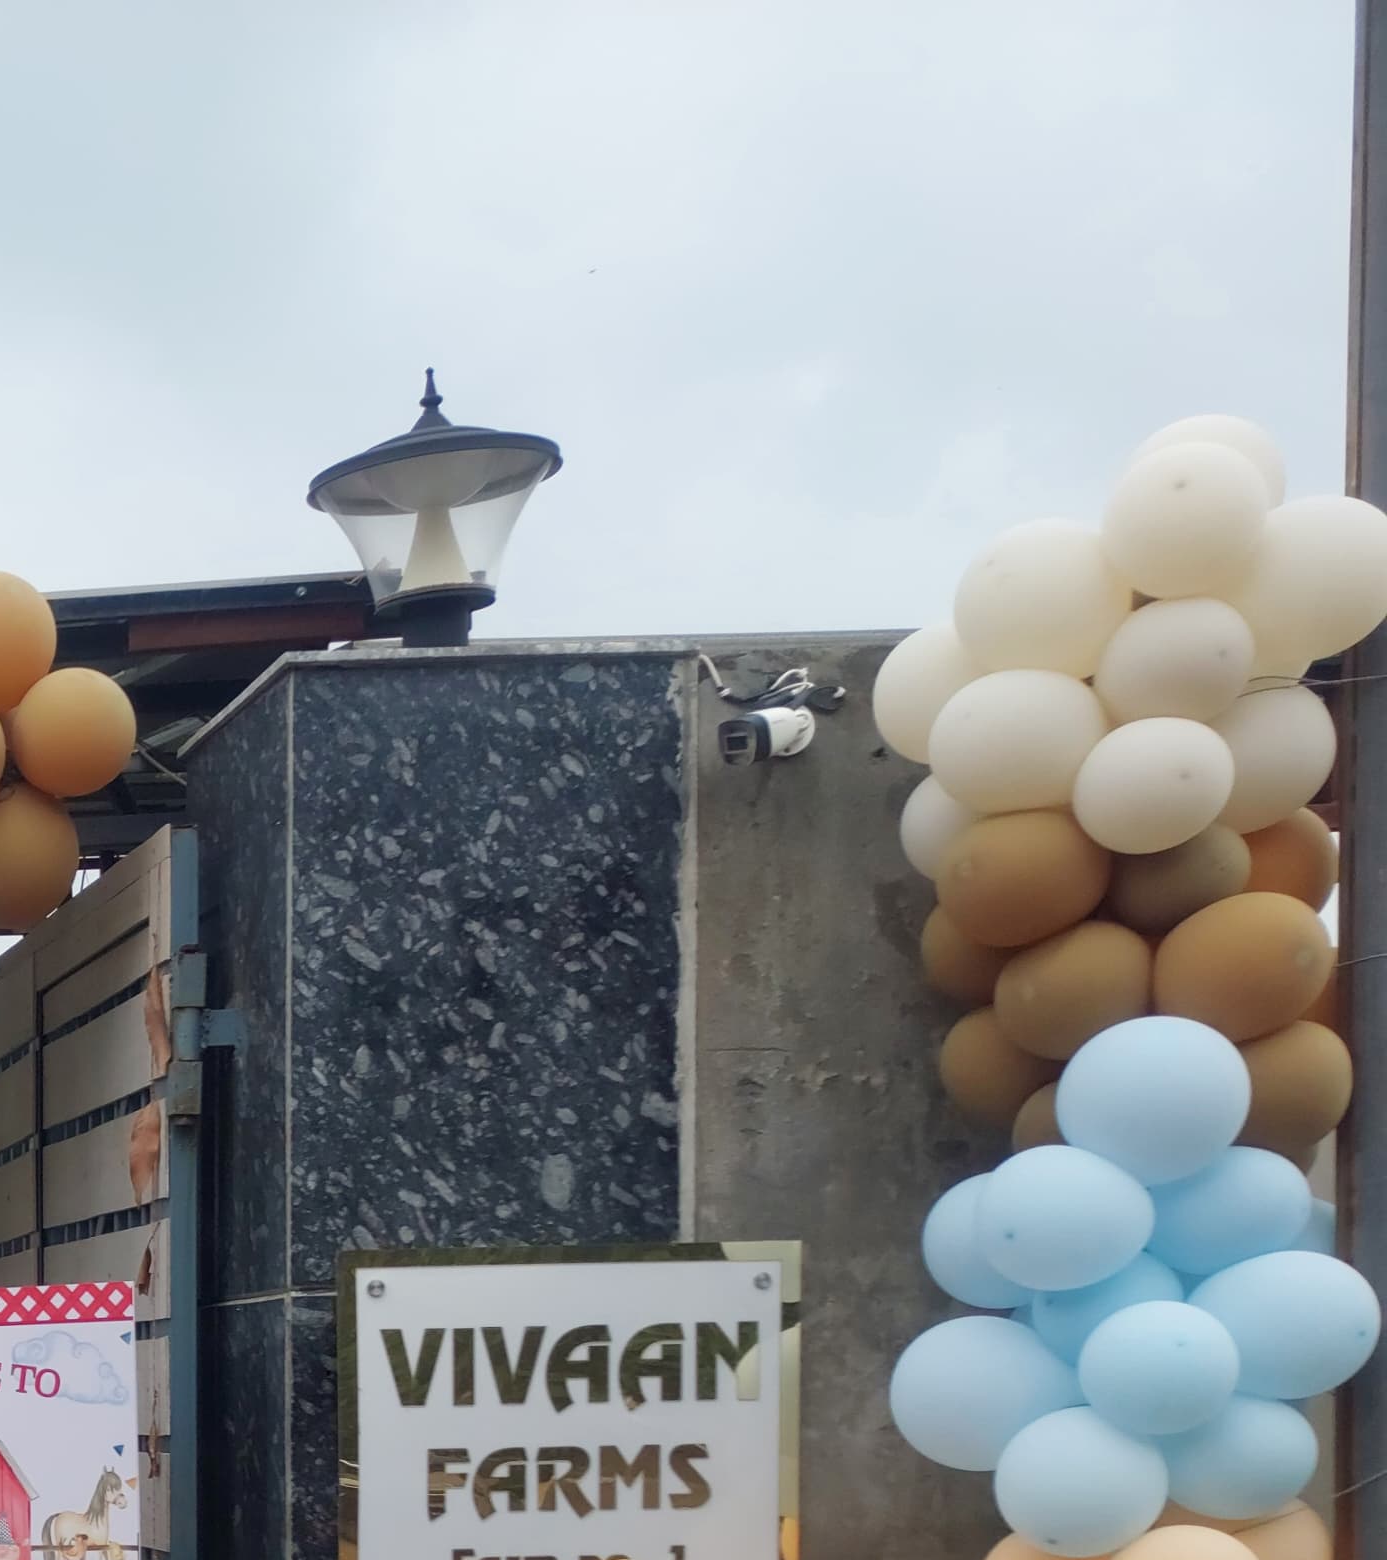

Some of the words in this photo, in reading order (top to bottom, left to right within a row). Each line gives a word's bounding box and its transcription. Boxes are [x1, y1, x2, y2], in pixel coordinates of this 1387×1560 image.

[10, 1362, 62, 1399] TO
[378, 1320, 761, 1414] VIVAAN
[426, 1442, 713, 1522] FARMS
